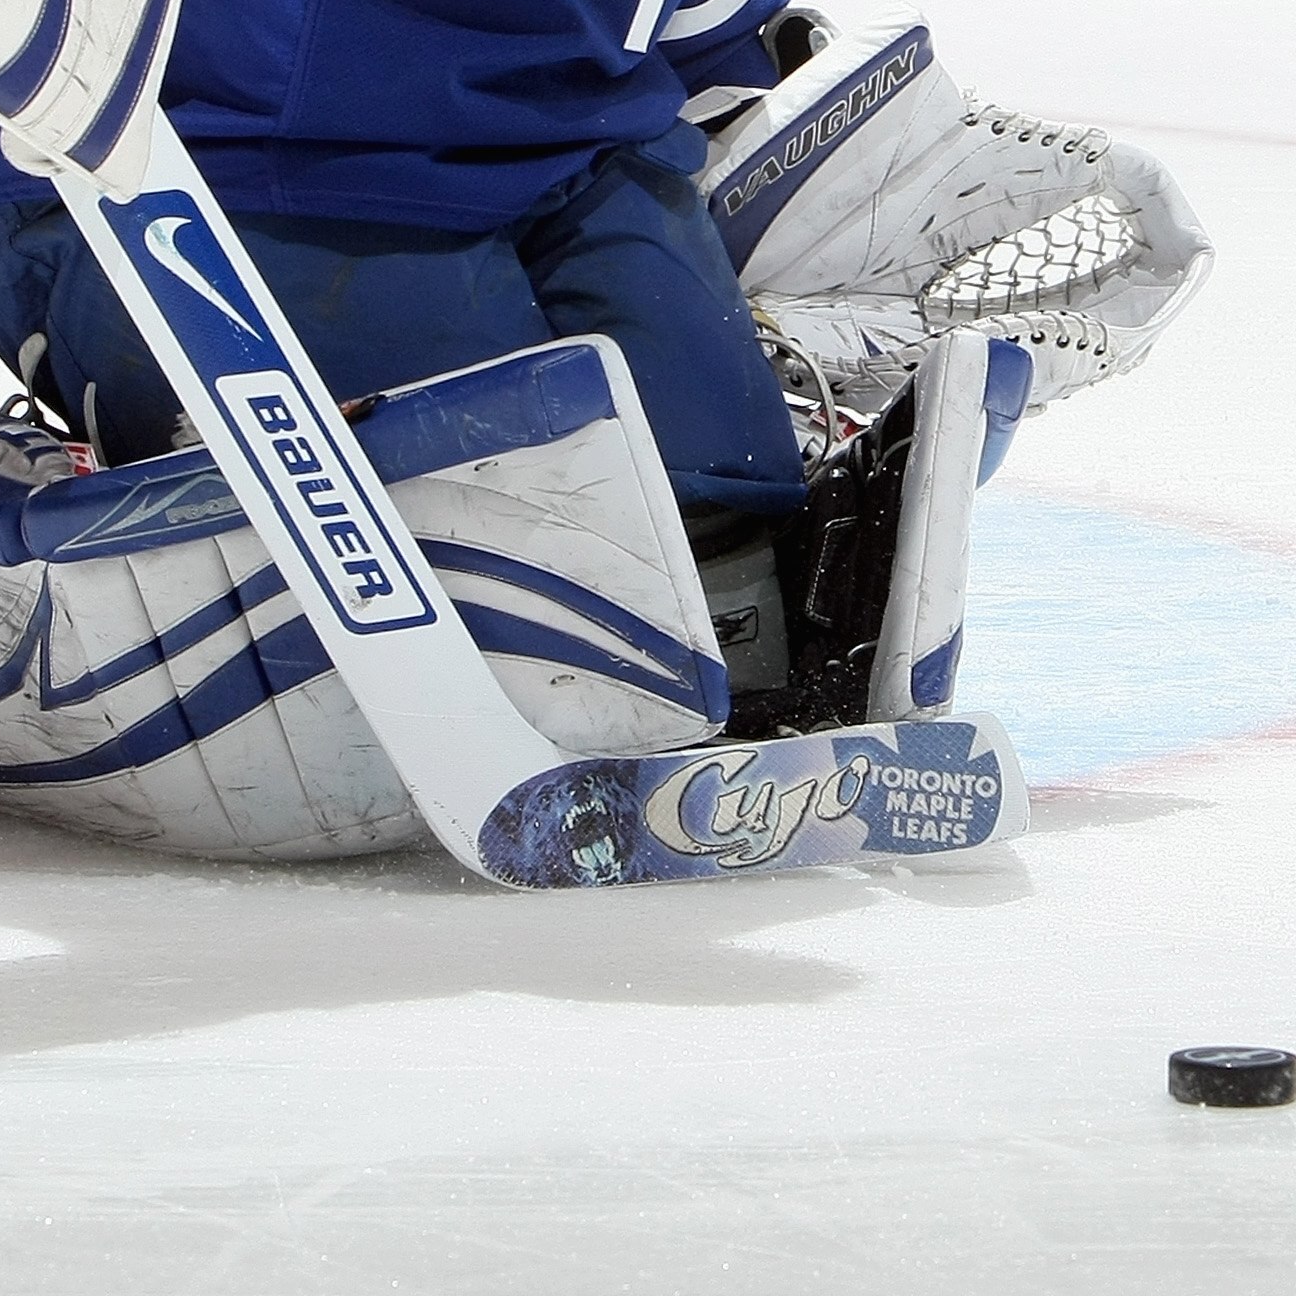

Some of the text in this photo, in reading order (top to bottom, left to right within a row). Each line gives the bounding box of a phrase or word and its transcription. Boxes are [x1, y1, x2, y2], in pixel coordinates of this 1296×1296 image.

[722, 41, 921, 217] VAUGHN
[870, 764, 998, 799] TORONTO
[885, 789, 975, 821] MAPLE
[891, 816, 969, 845] LEAFS
